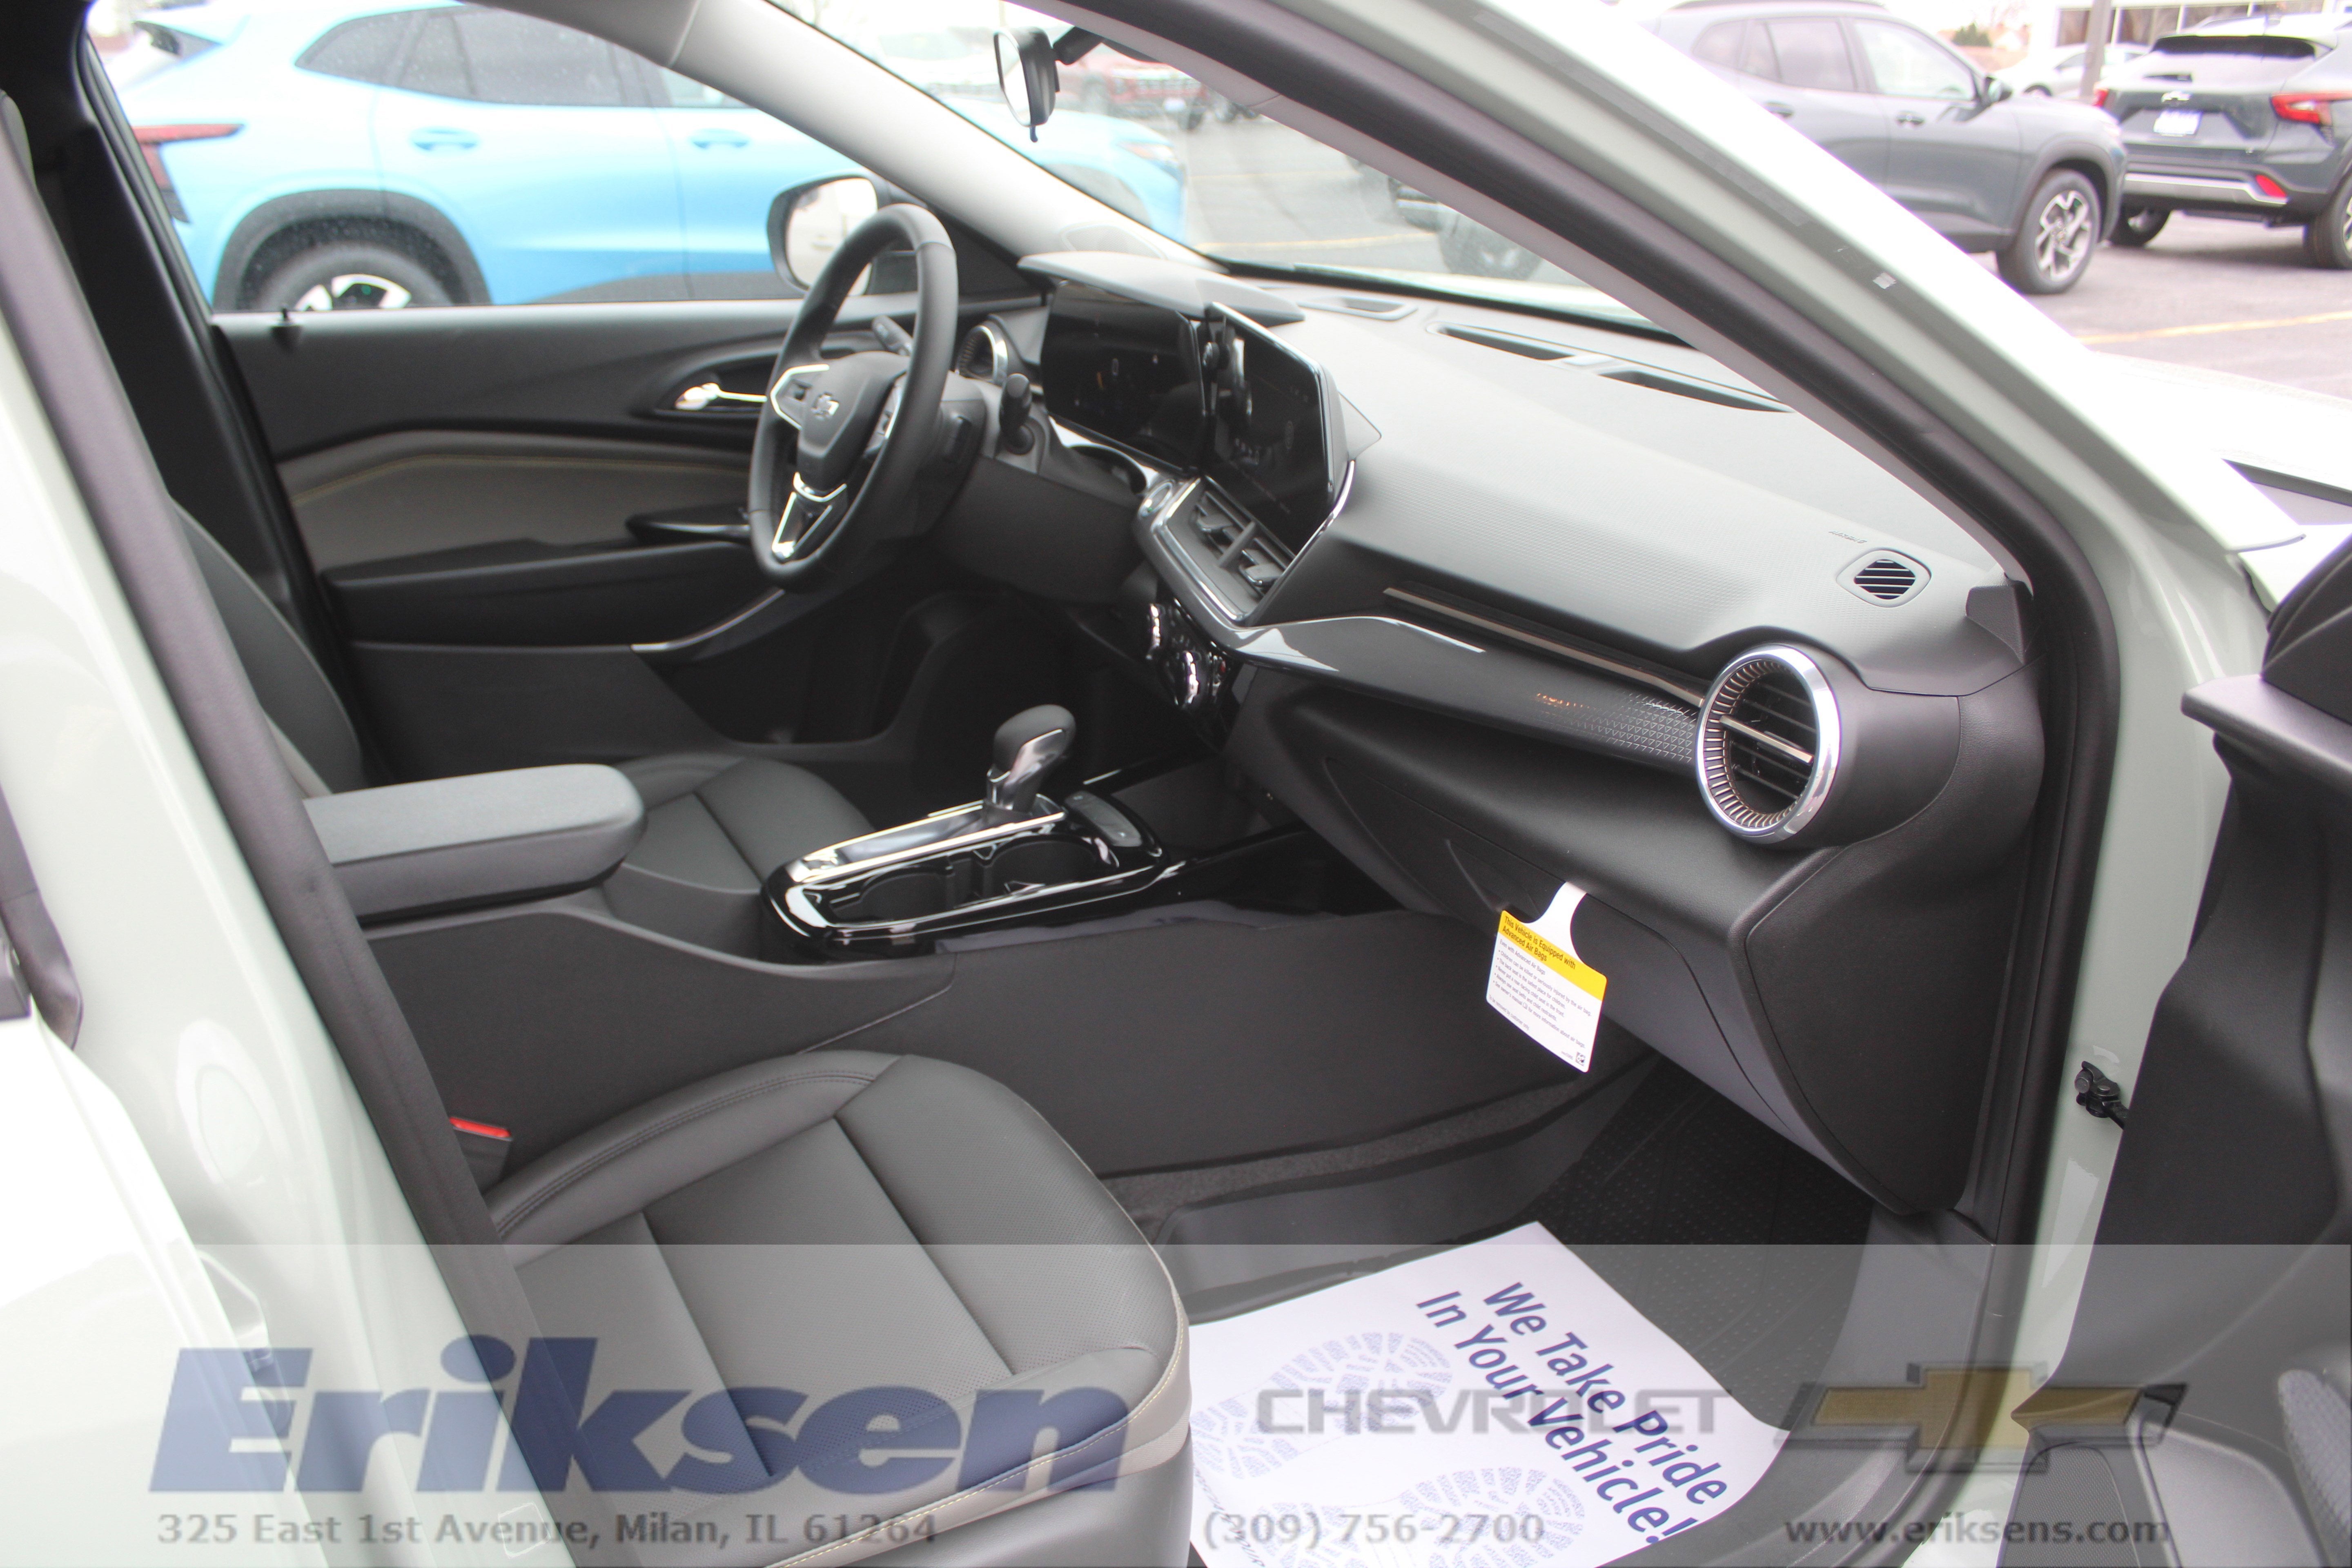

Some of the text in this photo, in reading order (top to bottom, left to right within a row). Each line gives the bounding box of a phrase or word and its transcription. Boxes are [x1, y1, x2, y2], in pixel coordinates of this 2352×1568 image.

[1503, 926, 1525, 946] Advanced
[1534, 948, 1547, 961] Bags
[1505, 916, 1575, 969] This Vehicle is Equipped with
[1415, 1290, 1699, 1546] In Your Vehicle!
[1482, 1281, 1728, 1505] We Take Pride
